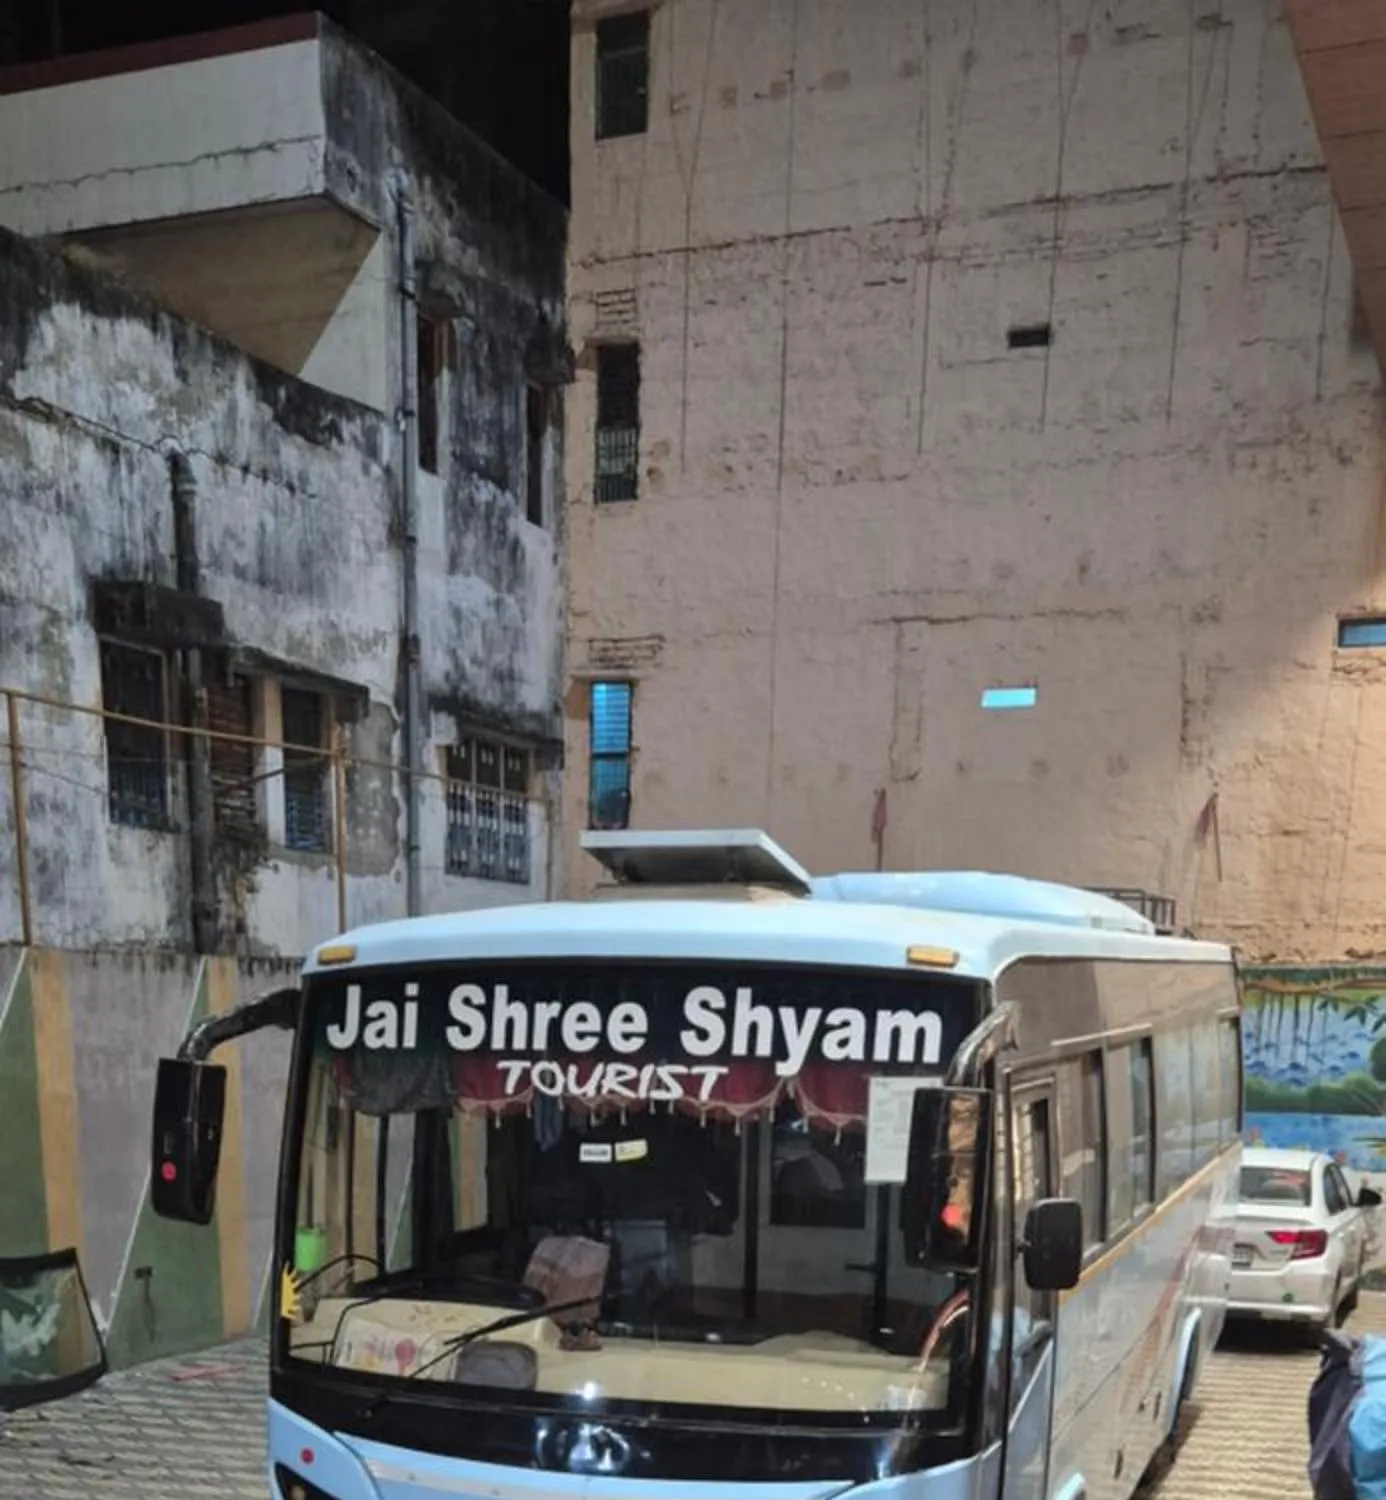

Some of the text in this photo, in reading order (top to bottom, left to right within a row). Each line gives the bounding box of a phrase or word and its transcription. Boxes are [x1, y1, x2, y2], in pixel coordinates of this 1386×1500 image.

[326, 983, 943, 1077] Jai Shree Shyam
[496, 1059, 730, 1102] TOURIST
